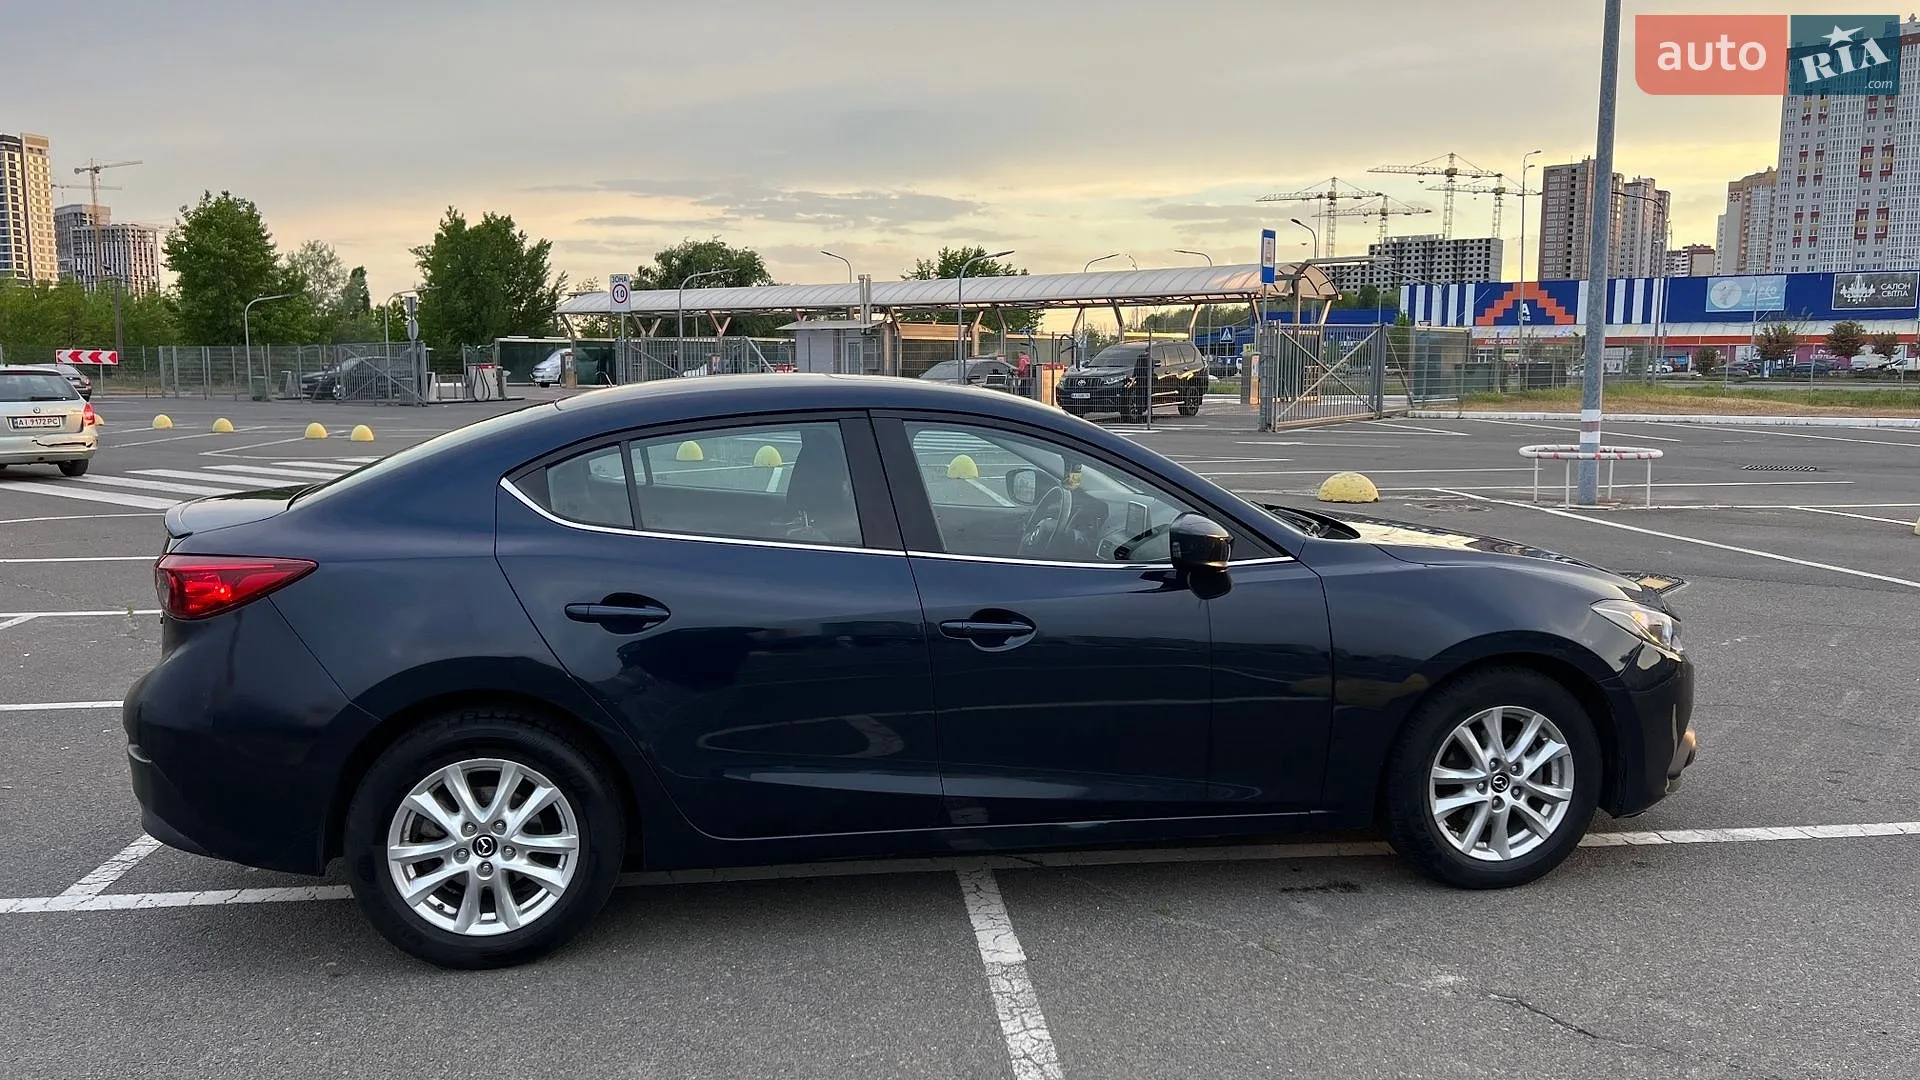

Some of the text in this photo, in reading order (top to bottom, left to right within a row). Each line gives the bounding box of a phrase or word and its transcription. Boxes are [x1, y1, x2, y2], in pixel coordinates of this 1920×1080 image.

[611, 275, 628, 283] ЗОНА
[1880, 282, 1911, 291] САЛОН
[615, 289, 625, 298] 10
[1881, 290, 1909, 298] СВІТЛА
